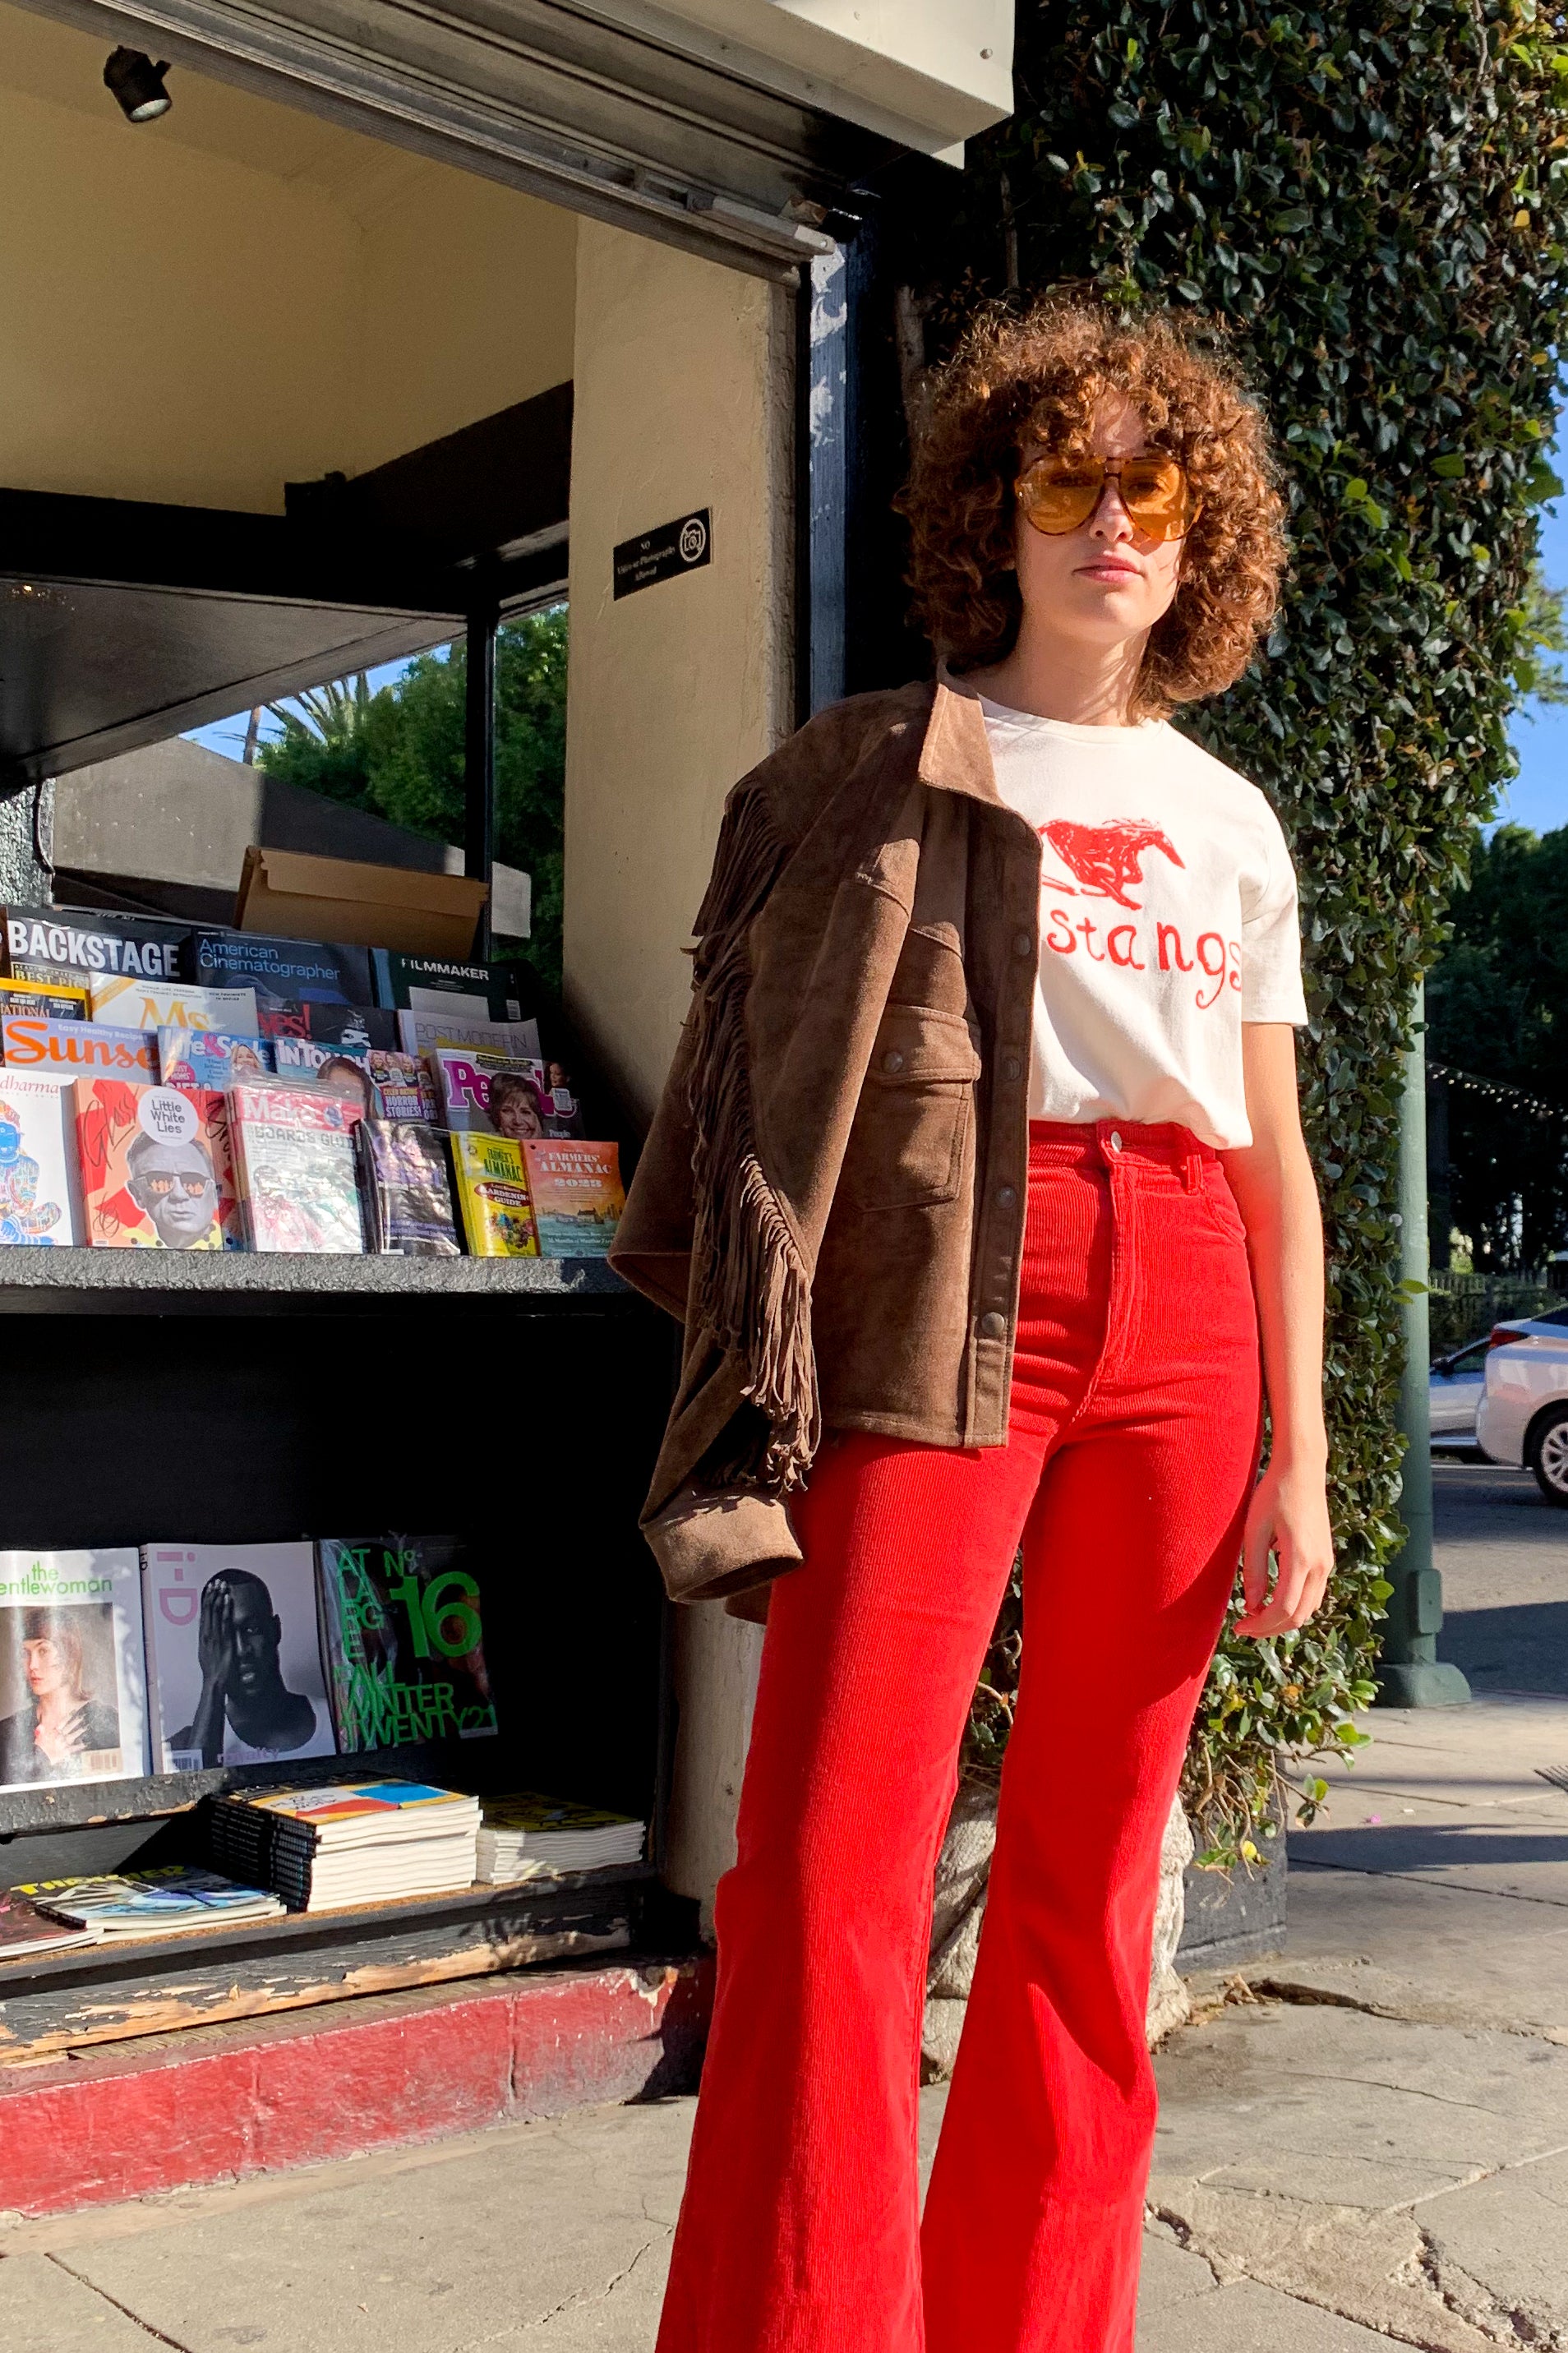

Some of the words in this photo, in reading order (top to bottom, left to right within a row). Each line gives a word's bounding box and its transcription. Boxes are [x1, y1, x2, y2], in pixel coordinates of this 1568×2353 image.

[8, 920, 181, 977] BACKSTAGE
[200, 939, 279, 960] American
[201, 953, 340, 980] Cinematographer
[401, 958, 490, 981] FILMMAKER
[15, 970, 53, 984] BEST
[150, 1110, 186, 1123] White
[151, 1100, 182, 1113] Little
[156, 1121, 182, 1134] Lies
[540, 1160, 612, 1174] ALMANAC
[31, 1561, 59, 1581] the
[389, 1571, 482, 1658] 16
